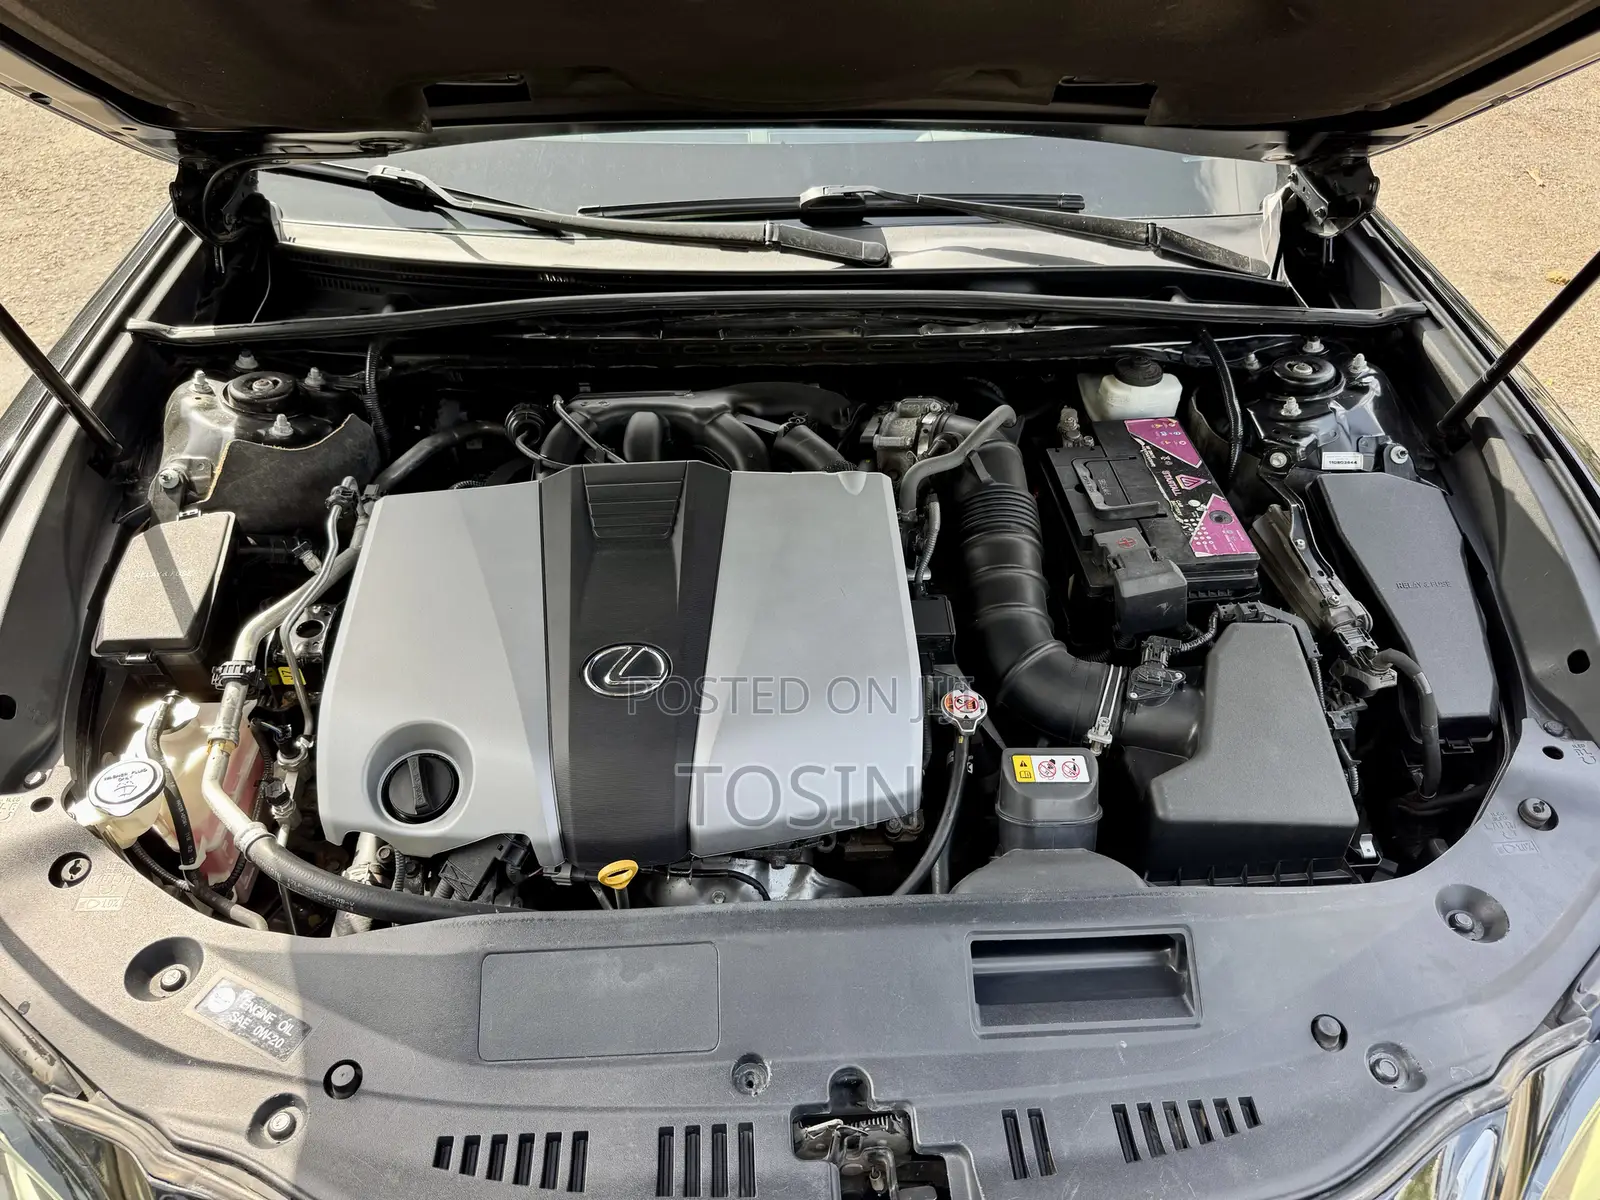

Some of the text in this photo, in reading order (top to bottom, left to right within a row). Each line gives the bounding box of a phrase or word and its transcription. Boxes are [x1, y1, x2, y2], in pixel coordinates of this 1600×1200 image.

[1396, 581, 1422, 590] RELAY
[1430, 580, 1452, 588] FUSE
[230, 1012, 285, 1049] SAE 0W-20
[239, 998, 278, 1025] ENGINE
[278, 1018, 296, 1037] OIL
